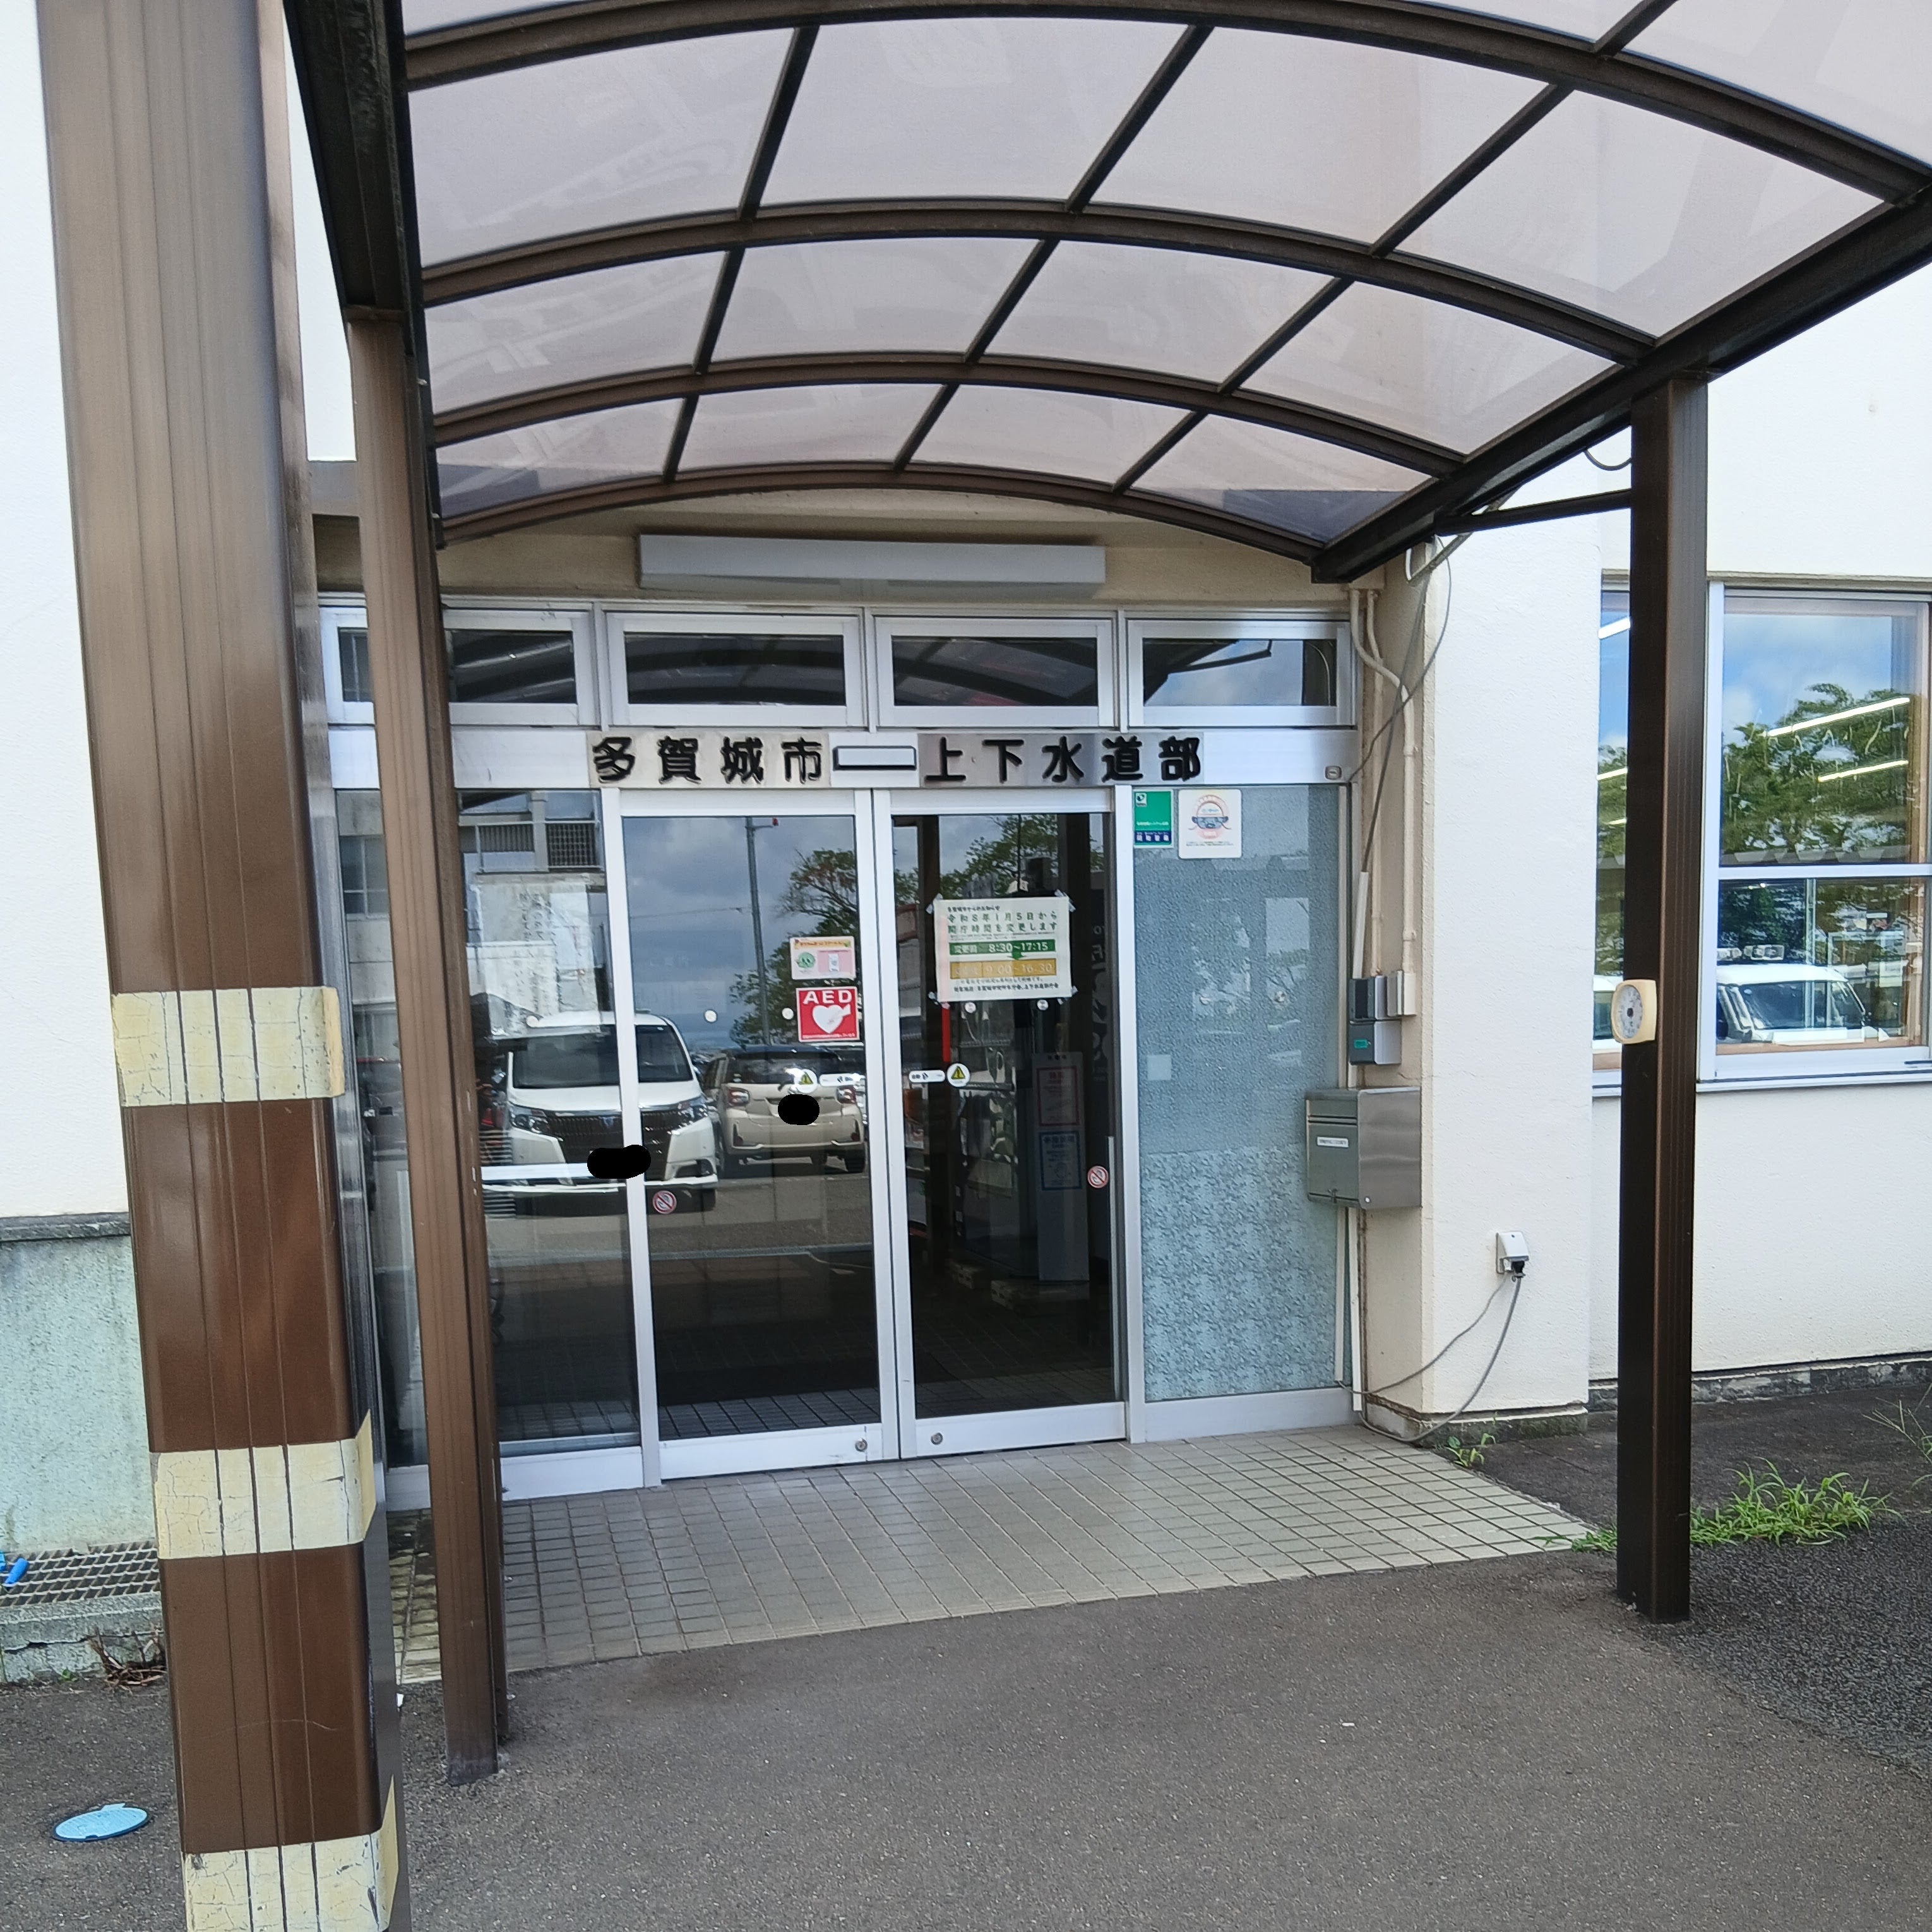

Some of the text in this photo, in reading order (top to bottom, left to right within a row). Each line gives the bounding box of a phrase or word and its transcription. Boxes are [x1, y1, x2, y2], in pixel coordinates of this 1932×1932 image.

[592, 736, 1200, 784] 多賀城市 上下水道部
[803, 990, 852, 1005] AED
